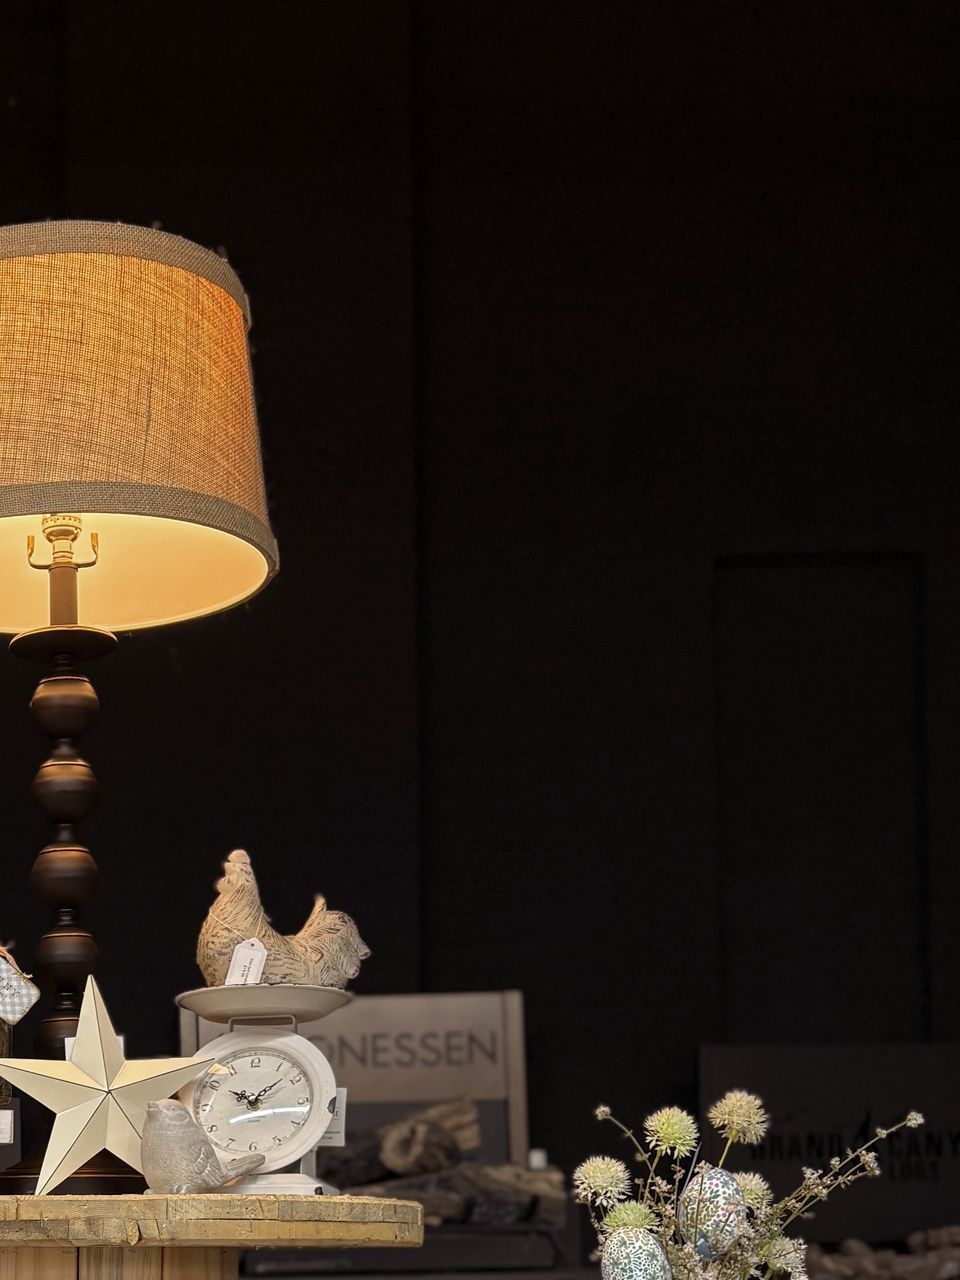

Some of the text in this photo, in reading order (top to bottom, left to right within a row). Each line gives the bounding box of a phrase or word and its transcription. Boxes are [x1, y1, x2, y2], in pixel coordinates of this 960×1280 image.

[250, 1056, 261, 1068] 12
[289, 1070, 302, 1086] 2
[208, 1079, 222, 1092] 10
[200, 1103, 213, 1113] 9
[206, 1124, 218, 1134] 8
[225, 1137, 236, 1148] 7
[248, 1141, 259, 1152] 6
